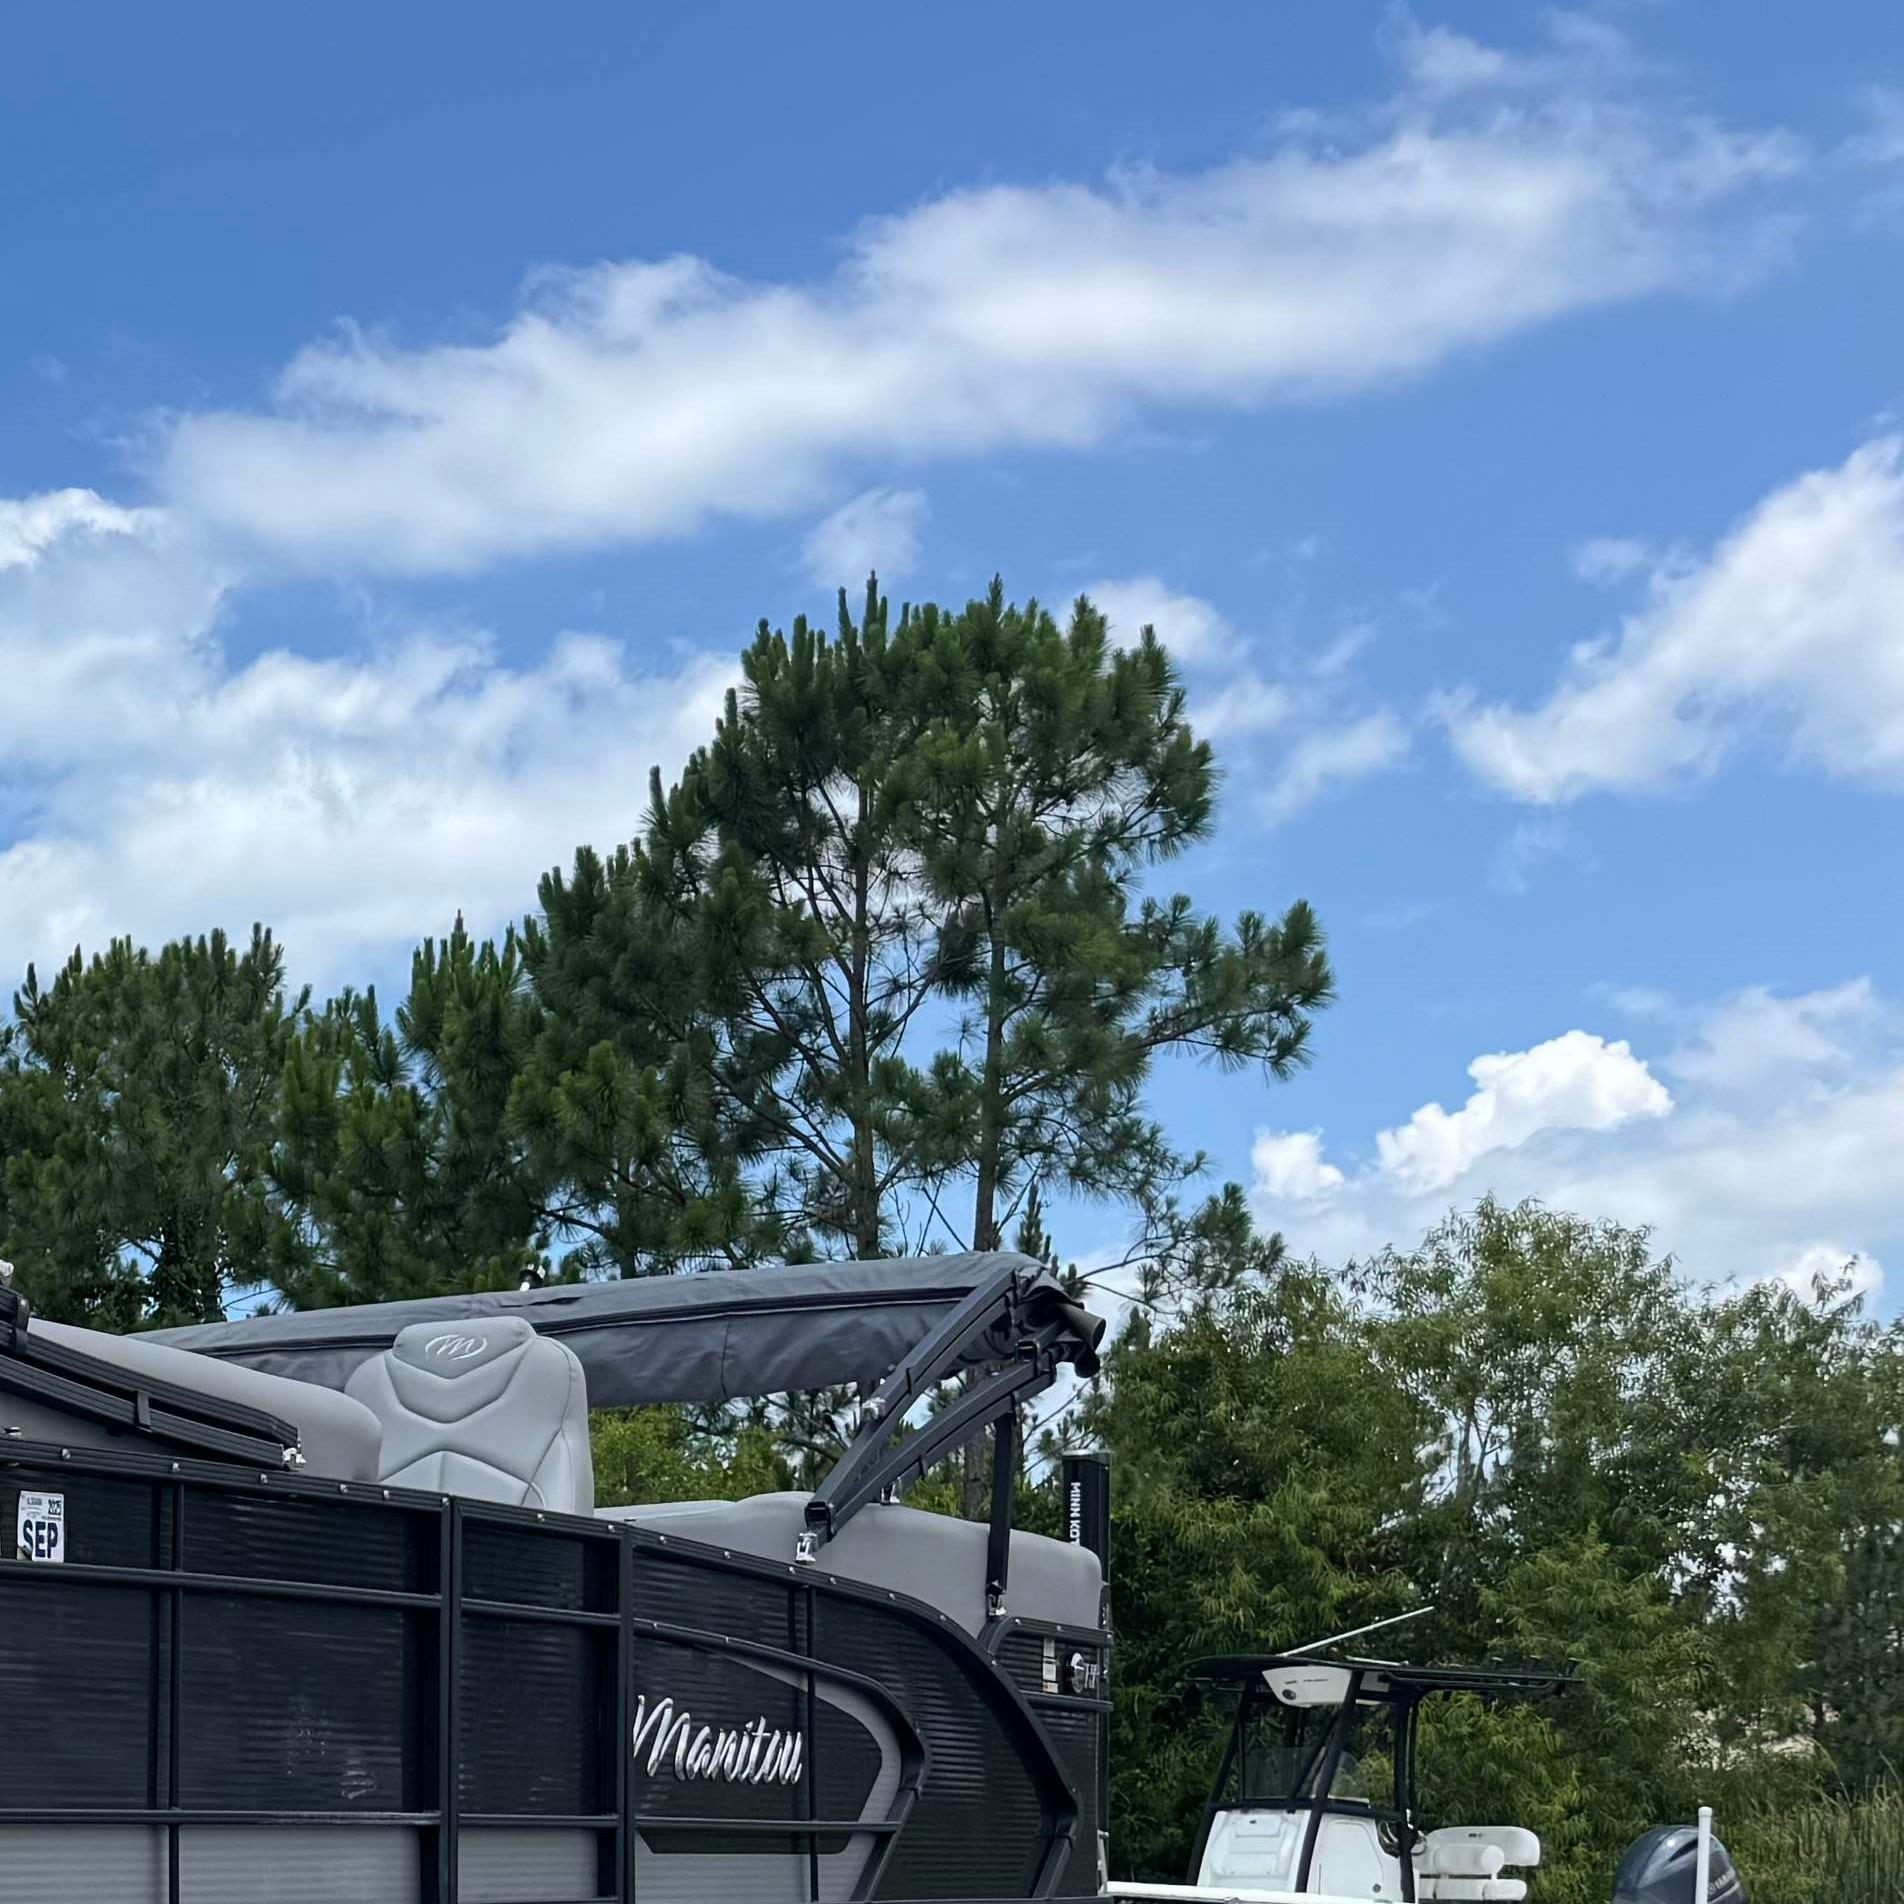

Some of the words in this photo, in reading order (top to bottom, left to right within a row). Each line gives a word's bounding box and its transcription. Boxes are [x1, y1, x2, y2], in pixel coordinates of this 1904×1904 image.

[1070, 1482, 1081, 1518] MINN
[23, 1519, 58, 1558] SEP
[1070, 1519, 1081, 1547] KOT
[633, 1694, 803, 1786] Manitou
